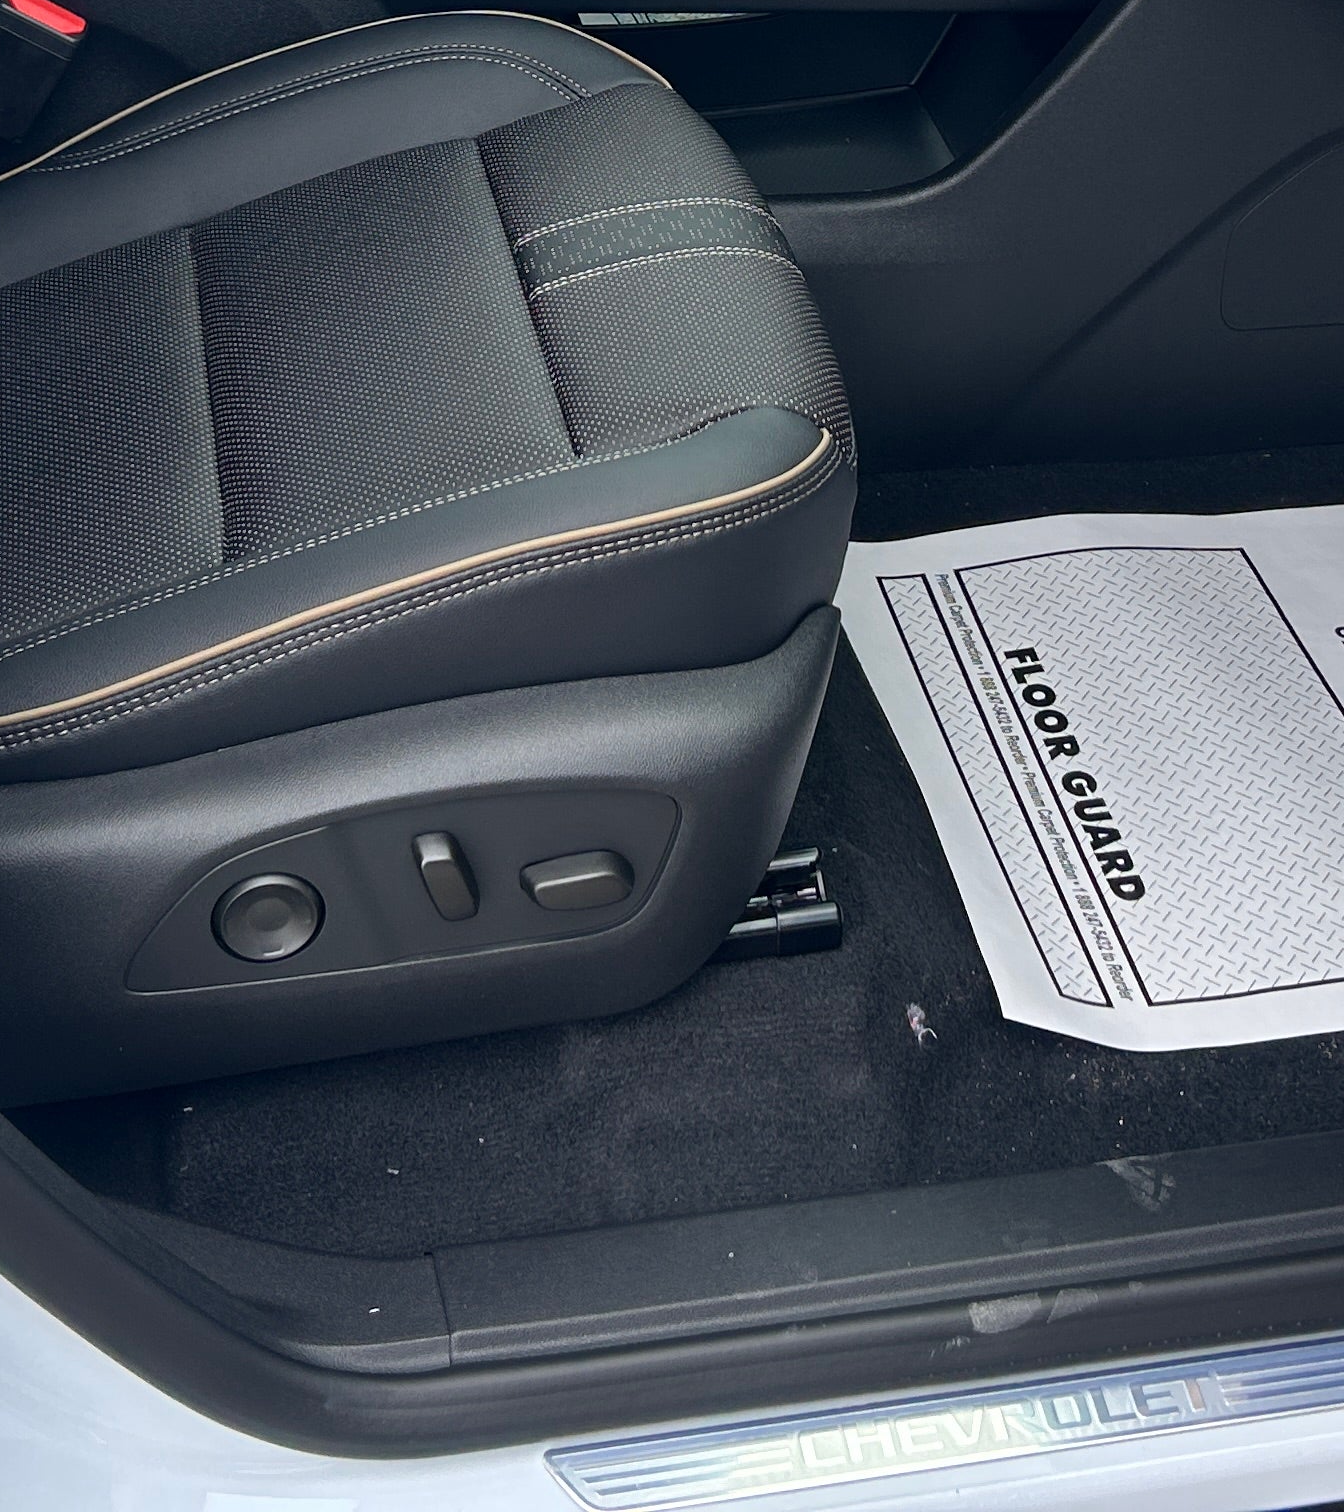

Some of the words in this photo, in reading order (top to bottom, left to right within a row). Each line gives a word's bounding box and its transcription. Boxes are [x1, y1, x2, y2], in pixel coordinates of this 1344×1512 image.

[935, 573, 956, 604] Premium
[949, 605, 969, 629] Carpet
[959, 628, 983, 665] Protection
[1001, 725, 1014, 734] to
[1006, 734, 1028, 766] Reorder
[1004, 647, 1080, 761] FLOOR
[1061, 770, 1146, 901] GUARD
[1020, 772, 1045, 807] Premium
[1037, 808, 1061, 835] Carpet
[1050, 834, 1078, 880] Protection
[1101, 952, 1115, 962] to
[1106, 963, 1134, 1001] Reorder
[798, 1377, 1209, 1469] CHEVROLET
